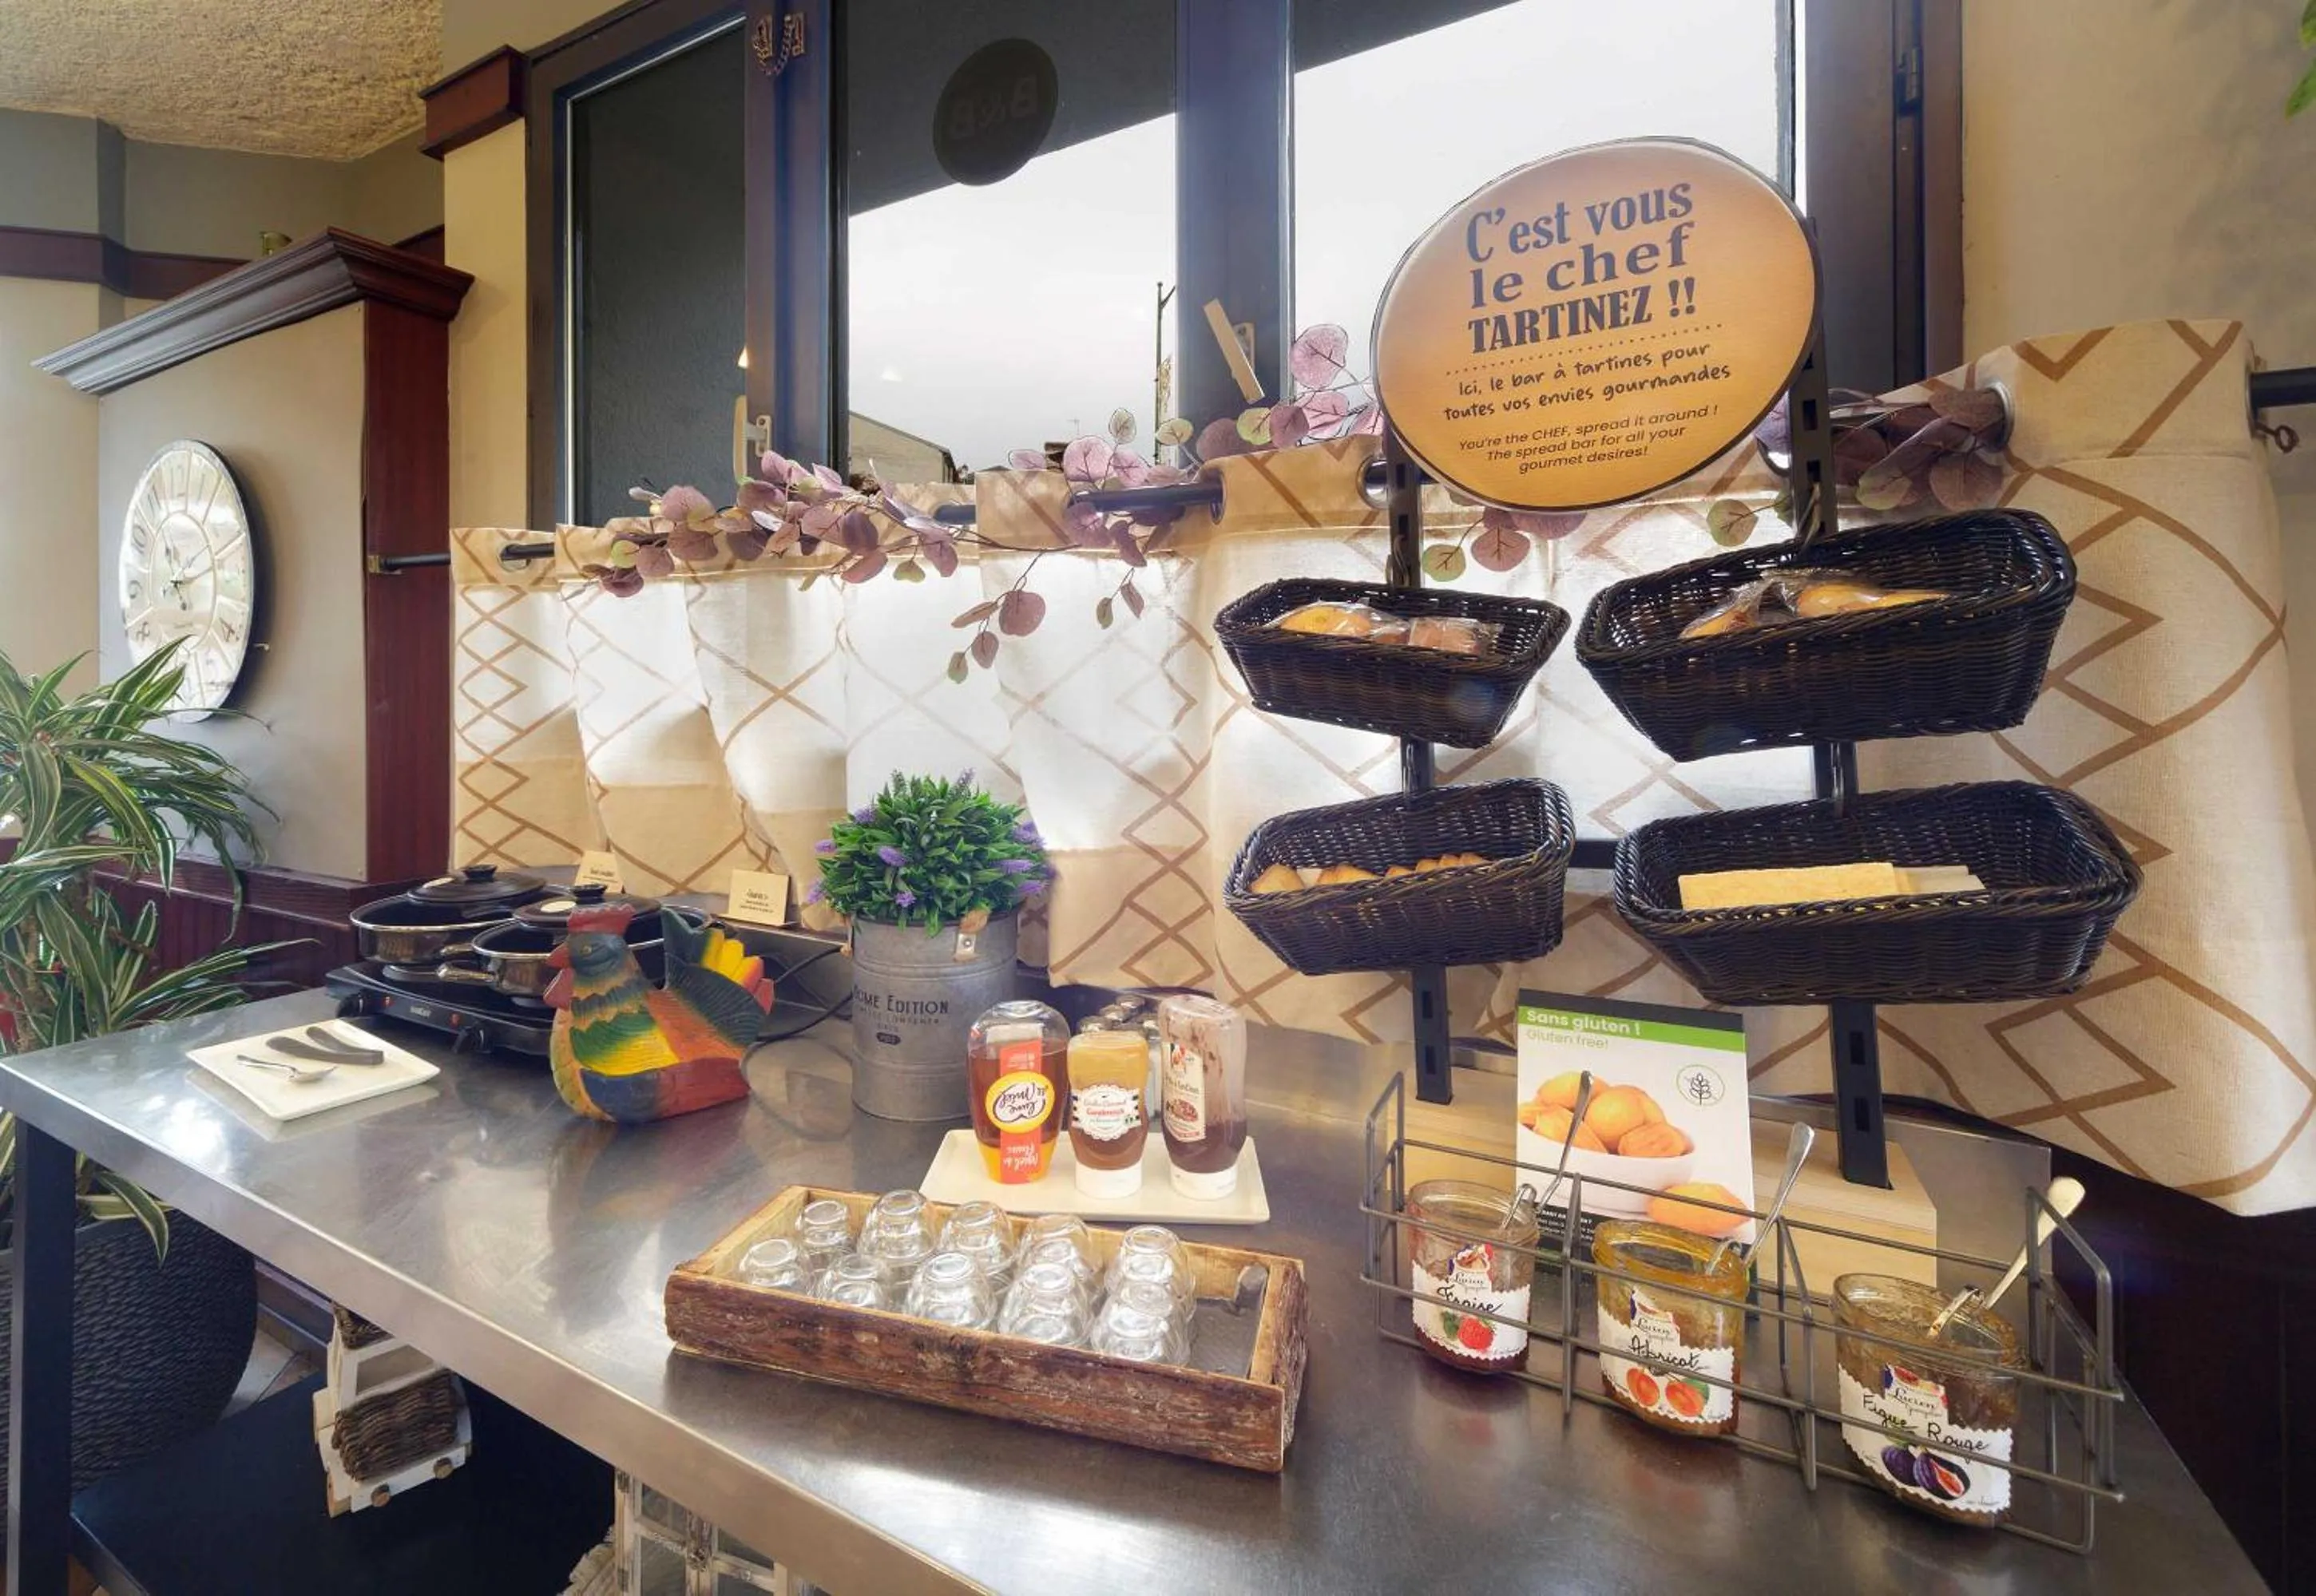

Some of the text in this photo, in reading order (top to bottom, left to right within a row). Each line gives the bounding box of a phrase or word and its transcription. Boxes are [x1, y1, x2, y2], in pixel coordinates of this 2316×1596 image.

[1466, 183, 1693, 263] C'est vous
[1469, 221, 1695, 309] le chef
[1468, 277, 1695, 354] TARTINEZ !!
[1459, 343, 1711, 396] Ici, le bar à tartines pour
[1444, 364, 1731, 421] toutes vos envies gourmandes
[1459, 437, 1502, 451] You're
[1505, 433, 1529, 445] the
[1532, 426, 1572, 442] CHEF,
[1576, 415, 1630, 436] spread
[1634, 414, 1645, 426] it
[1648, 405, 1709, 425] around
[1487, 426, 1687, 461] The spread bar for all your
[1519, 446, 1648, 474] gourmet desires!
[887, 995, 949, 1015] EDITION
[1526, 1009, 1641, 1036] Sans gluten !
[1526, 1028, 1608, 1050] Gluten free!
[1437, 1284, 1505, 1313] Fraise
[1628, 1335, 1701, 1368] Abricot
[1863, 1394, 1989, 1464] Figue Rouge
